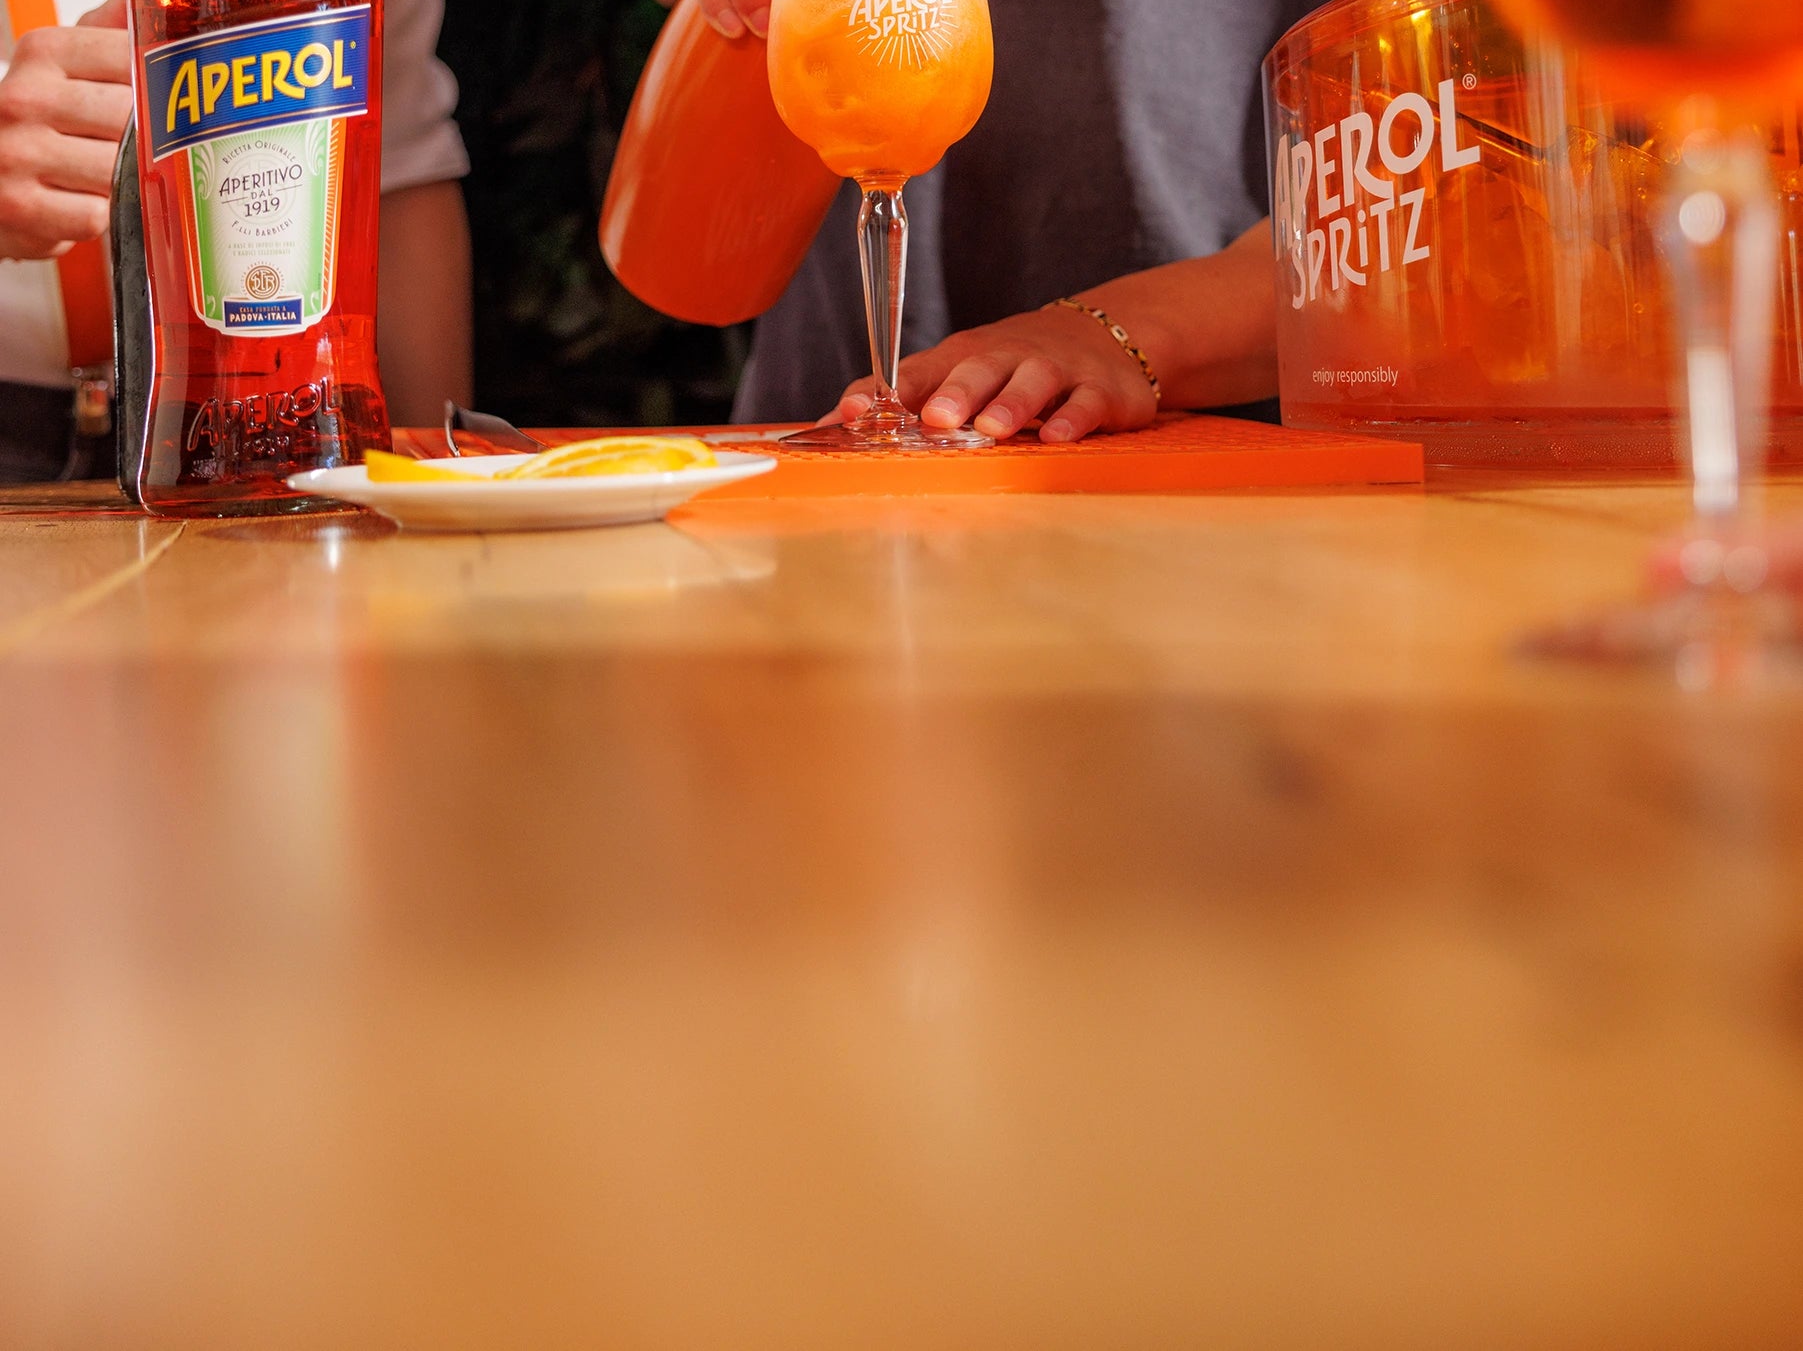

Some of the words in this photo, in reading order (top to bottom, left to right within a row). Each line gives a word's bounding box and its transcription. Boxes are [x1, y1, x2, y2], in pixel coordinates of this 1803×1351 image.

[166, 39, 353, 134] APEROL
[222, 143, 252, 165] RICETTA
[254, 140, 296, 163] ORIGINALE
[219, 163, 303, 197] APERITIVO
[1274, 77, 1481, 262] APEROL
[250, 189, 273, 200] DAL
[244, 196, 280, 218] 1919
[255, 218, 294, 237] BARBIERI
[1312, 367, 1335, 387] enjoy
[1336, 366, 1398, 387] responsibly
